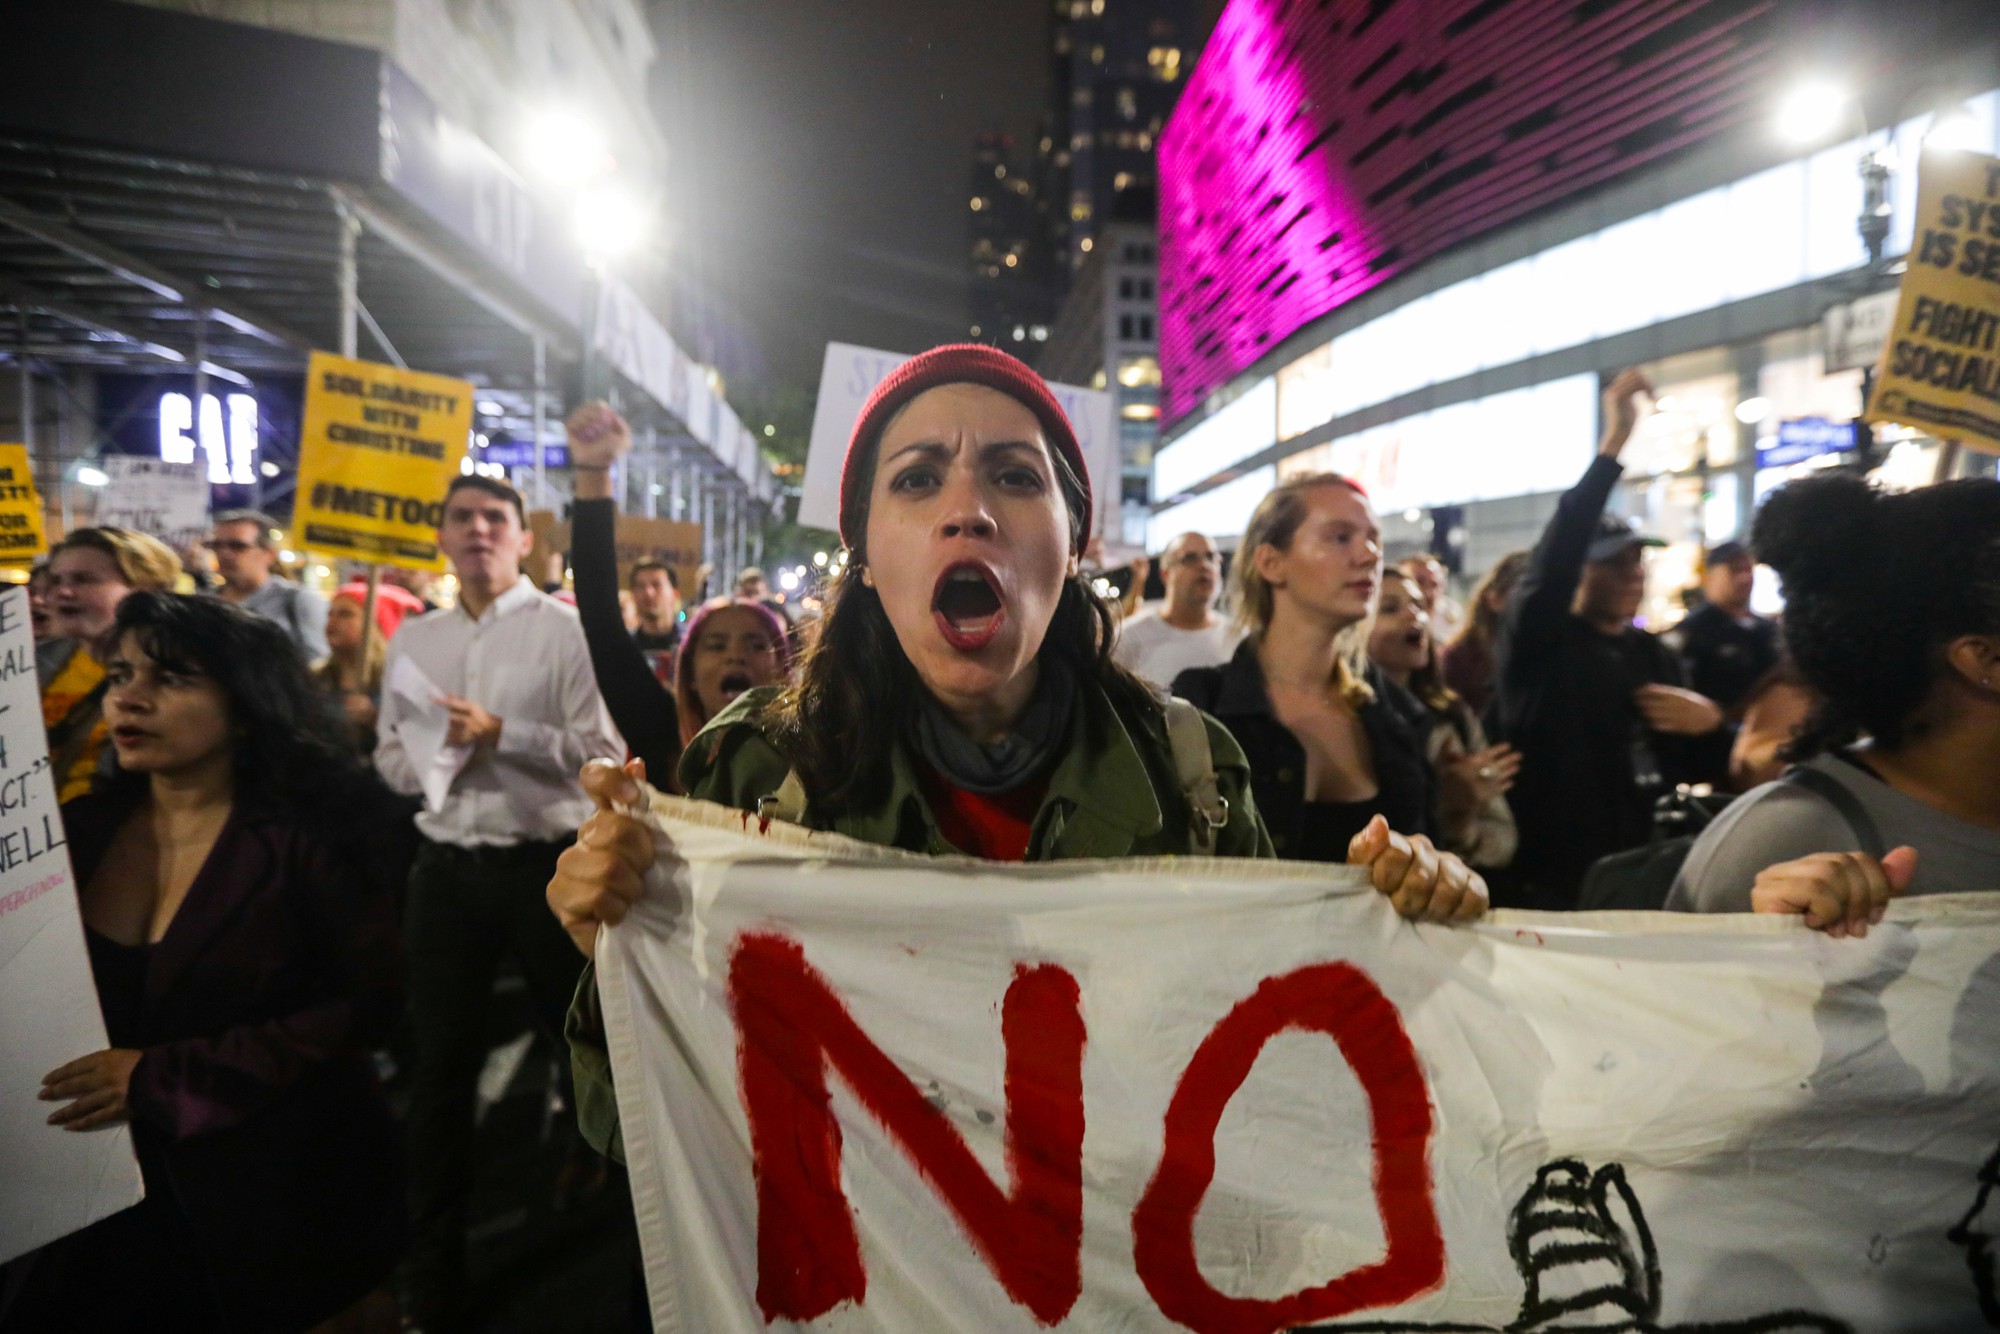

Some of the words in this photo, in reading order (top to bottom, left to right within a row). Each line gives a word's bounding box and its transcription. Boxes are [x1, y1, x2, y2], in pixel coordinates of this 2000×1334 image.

[1918, 228, 1957, 269] IS
[1909, 294, 2000, 351] FIGHT
[322, 371, 458, 415] SOLIDARITY
[361, 404, 420, 432] WITH
[326, 421, 447, 463] CHRISTINE
[311, 482, 446, 530] #METOO
[727, 929, 1446, 1334] NO
